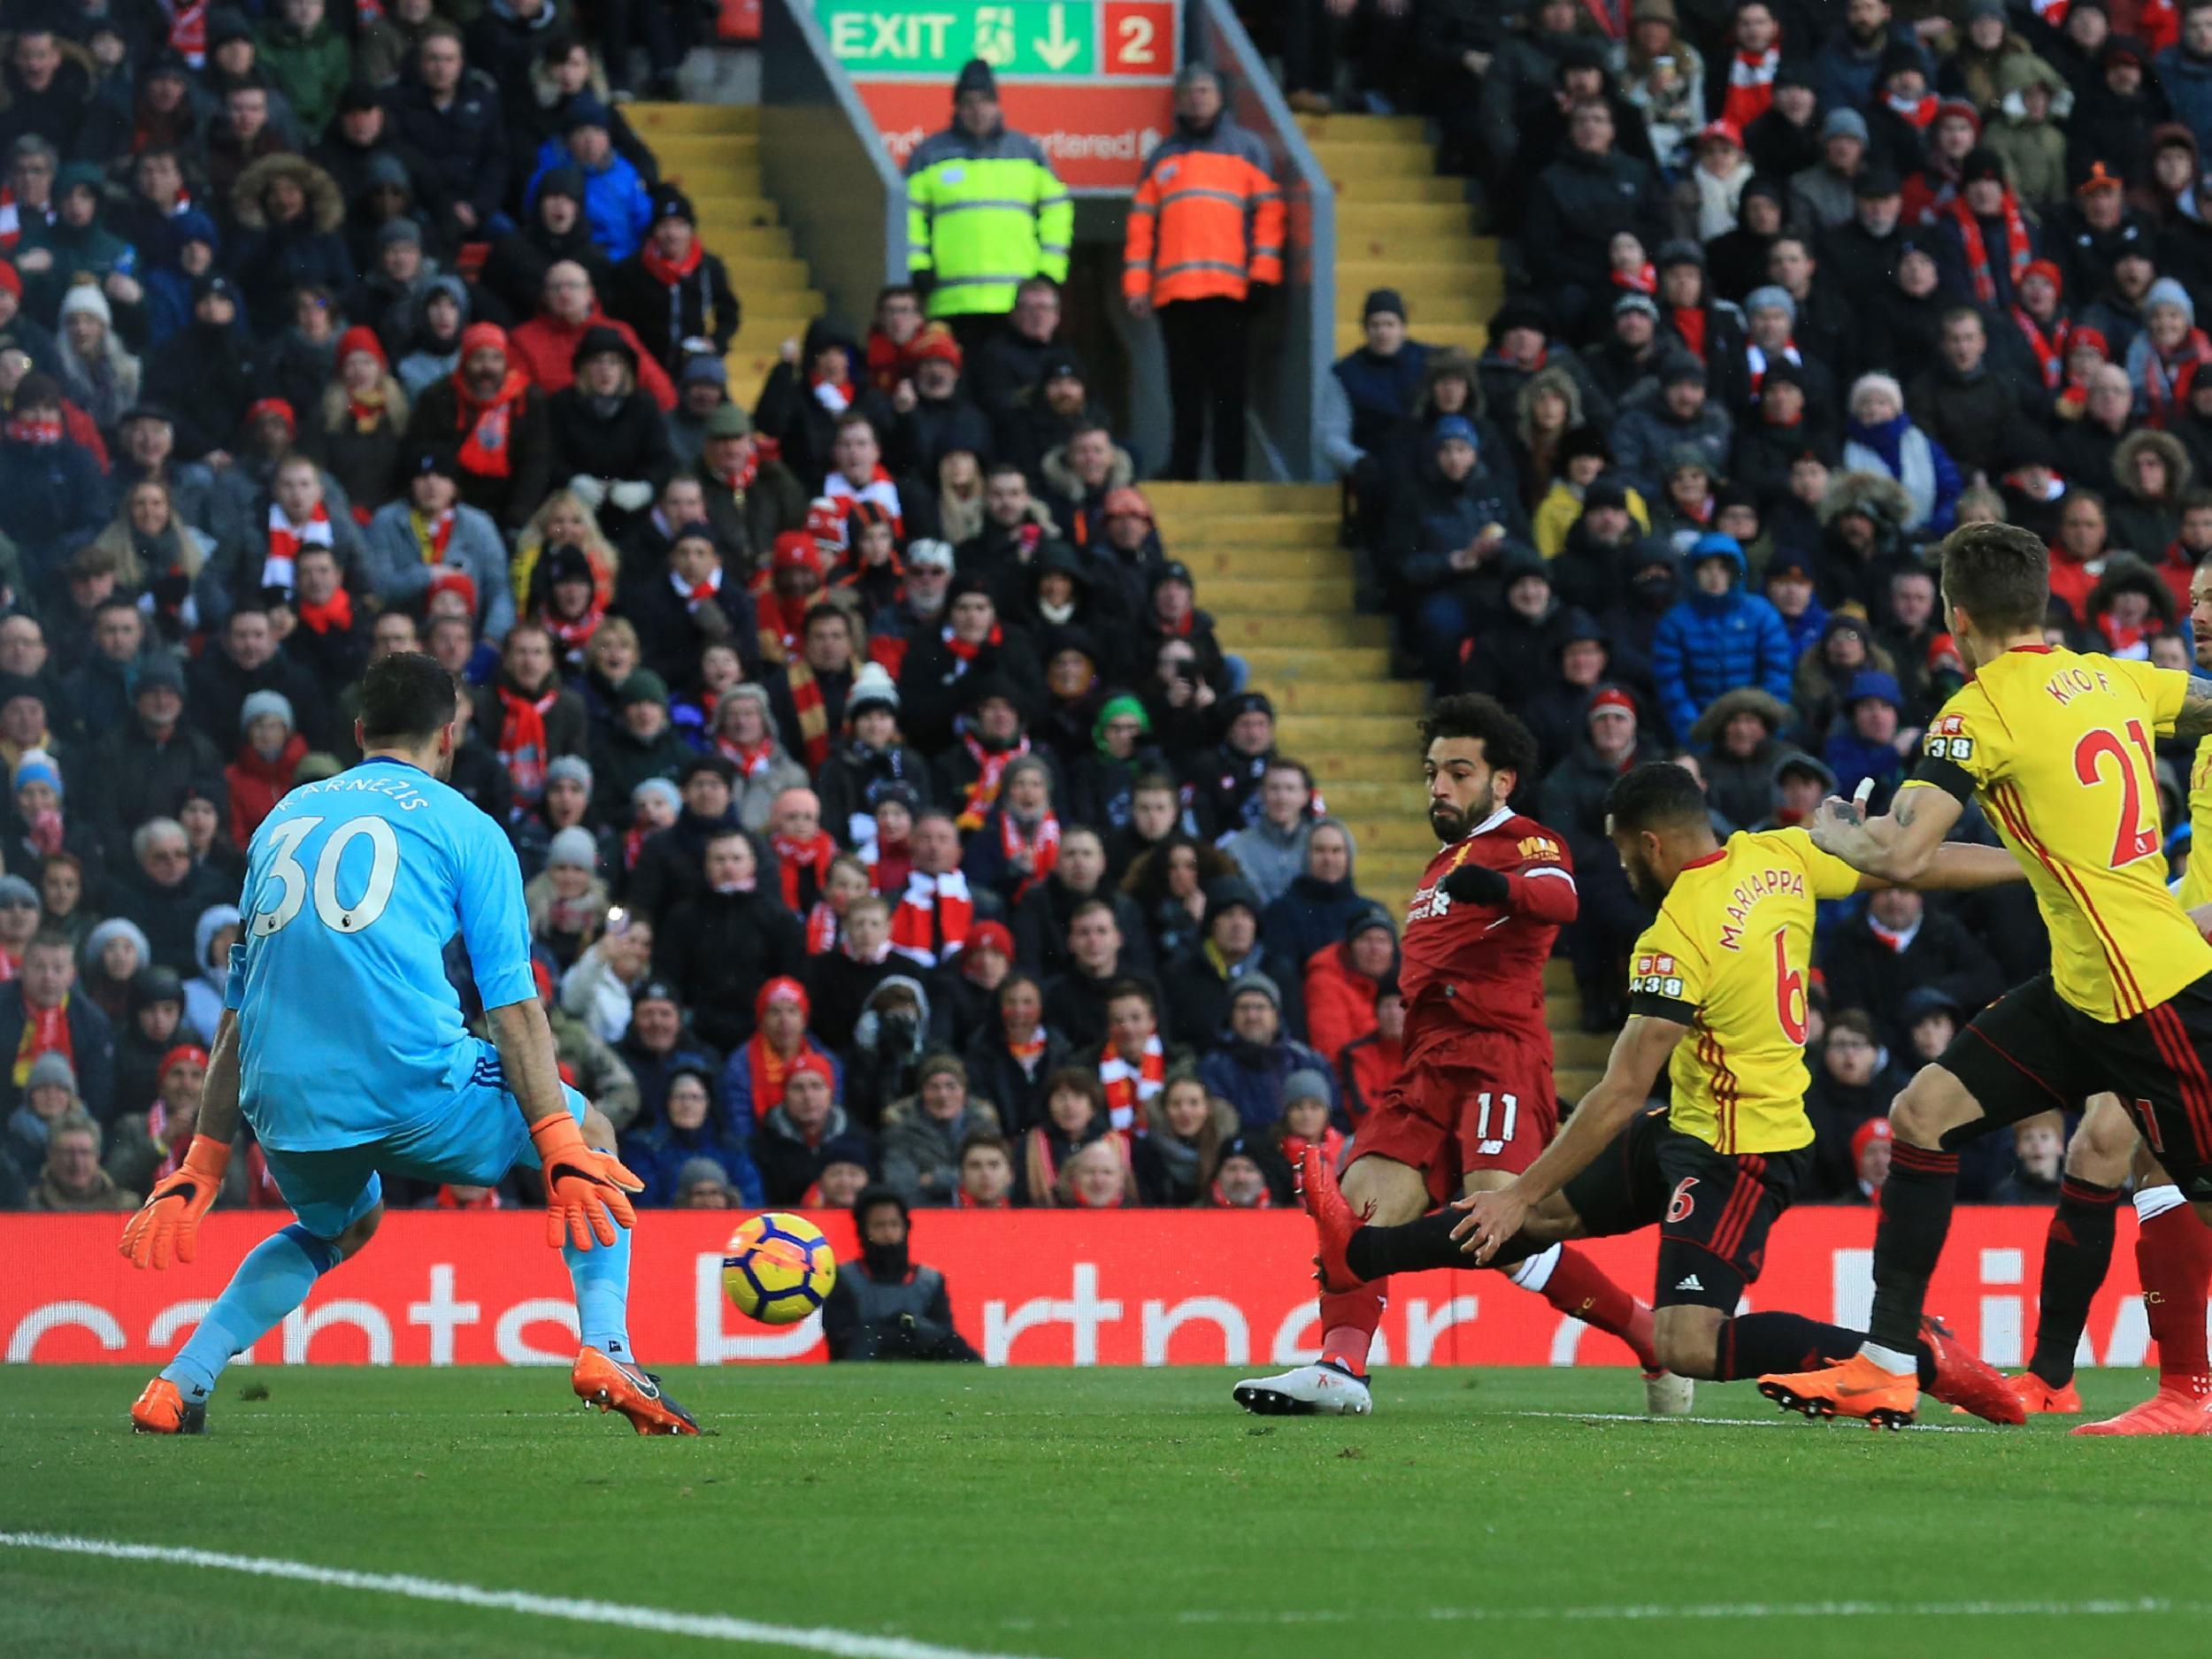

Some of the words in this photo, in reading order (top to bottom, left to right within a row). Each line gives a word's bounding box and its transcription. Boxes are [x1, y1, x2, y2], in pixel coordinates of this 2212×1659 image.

[831, 12, 956, 59] EXIT
[1118, 15, 1154, 63] 2
[1033, 127, 1136, 159] rtered
[275, 777, 429, 811] KARNEZIS
[2074, 718, 2162, 869] 21
[253, 814, 399, 933] 30
[1719, 870, 1806, 951] MARIAPPA
[1773, 923, 1809, 1047] 6
[1477, 1092, 1518, 1142] 11
[1665, 1176, 1701, 1224] 6
